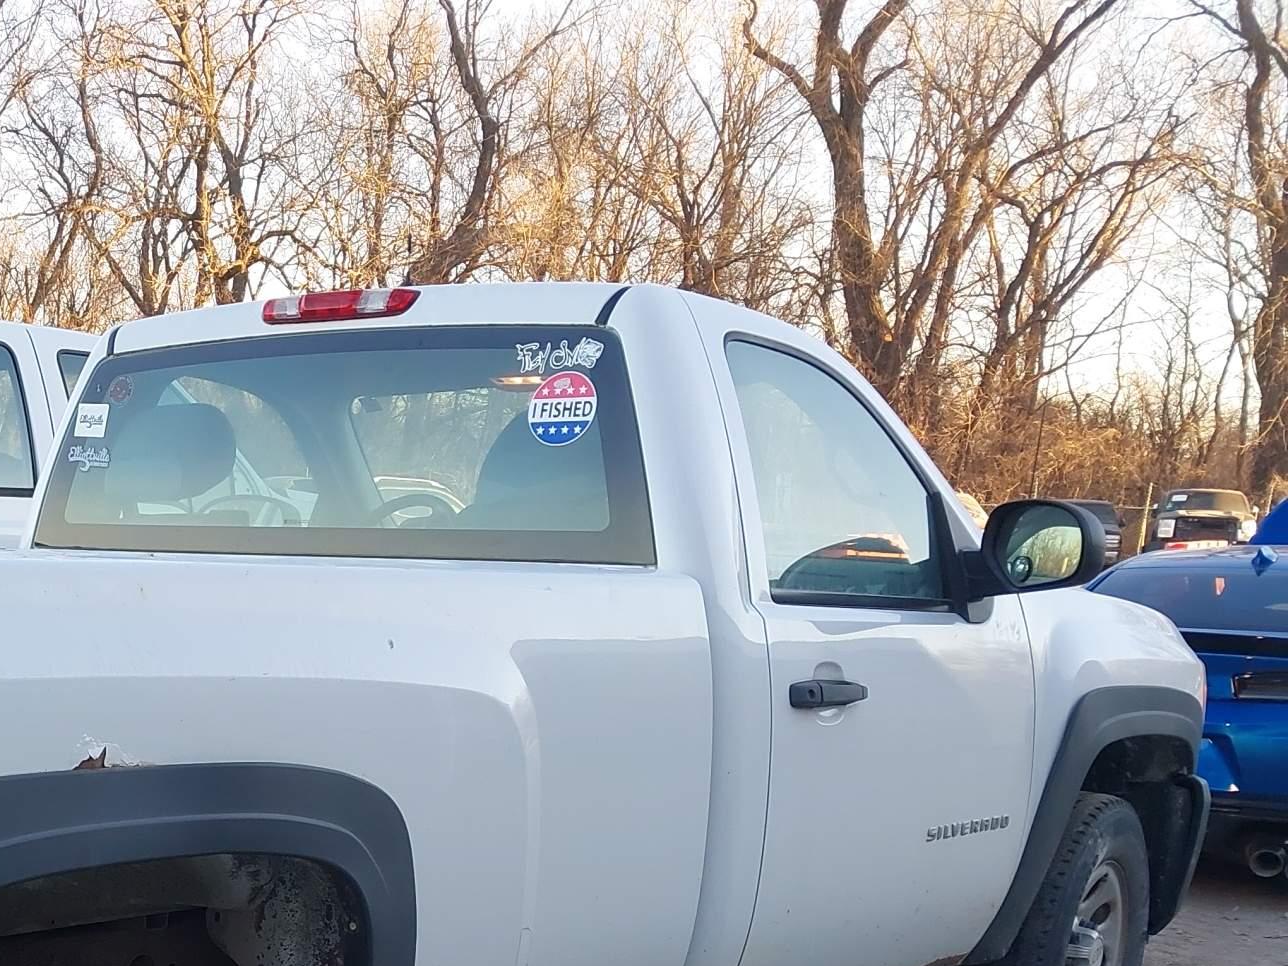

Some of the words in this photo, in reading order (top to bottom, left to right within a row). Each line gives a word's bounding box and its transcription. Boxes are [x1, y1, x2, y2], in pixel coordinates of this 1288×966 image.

[532, 403, 538, 418] I
[540, 401, 593, 418] FISHED
[925, 814, 1010, 842] SILVERADO
